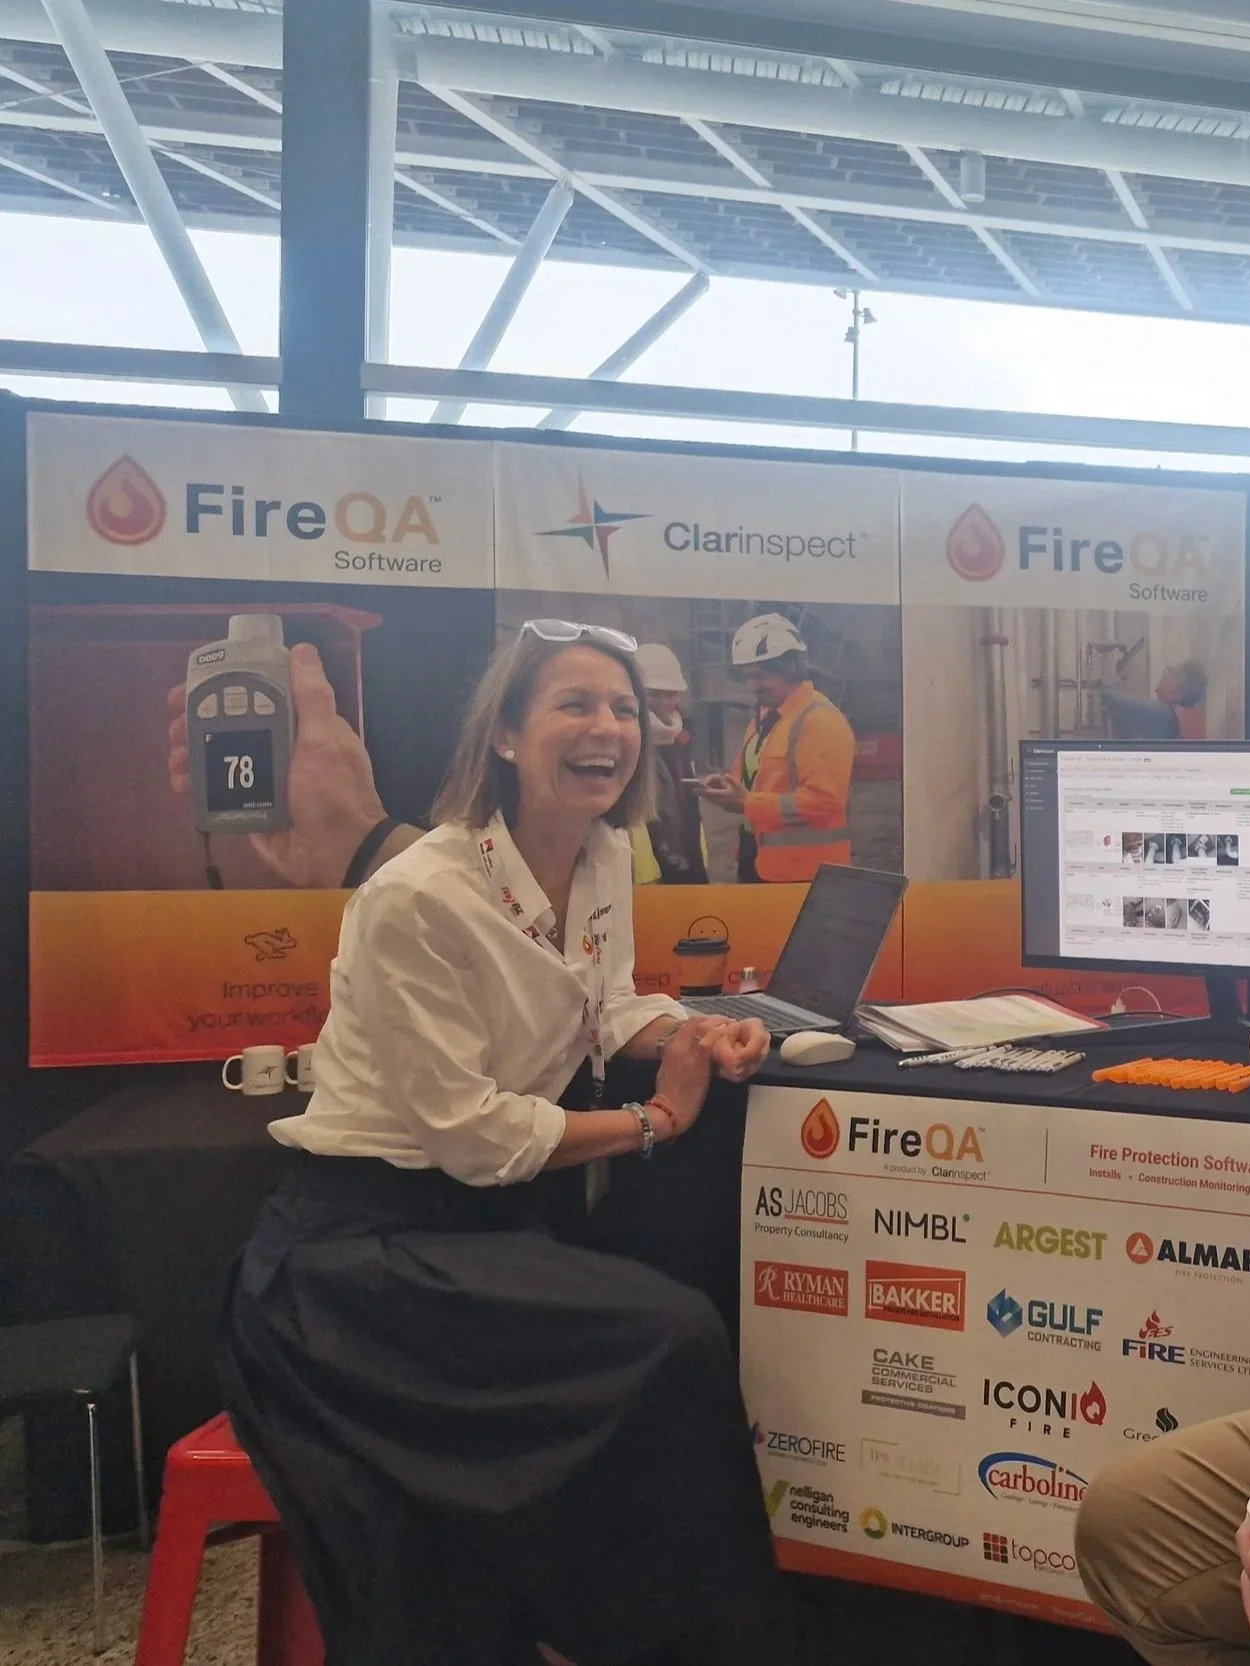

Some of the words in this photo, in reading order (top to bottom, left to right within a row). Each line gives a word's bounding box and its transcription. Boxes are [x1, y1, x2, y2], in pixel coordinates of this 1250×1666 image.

[185, 482, 440, 545] FireQA
[664, 522, 857, 562] Clarinspect
[334, 550, 442, 573] Software
[1129, 583, 1208, 602] Software
[224, 756, 254, 789] 78
[223, 981, 318, 1000] Improve
[849, 1117, 984, 1162] FireQA
[1090, 1144, 1118, 1161] Fire
[1122, 1148, 1199, 1170] Protection
[932, 1166, 987, 1181] Clarinspect
[1089, 1167, 1121, 1180] Installs
[1138, 1172, 1198, 1189] Construction
[1200, 1179, 1250, 1195] Monitoring
[755, 1223, 793, 1238] Property
[794, 1225, 849, 1243] Consultancy
[874, 1208, 967, 1244] NIMBL
[993, 1221, 1107, 1261] ARGEST
[783, 1270, 844, 1297] RYMAN
[783, 1291, 844, 1309] HEALTHCARE
[872, 1283, 956, 1315] BAKKER
[1028, 1299, 1103, 1335] GULF
[1028, 1331, 1102, 1351] CONTRACTING
[873, 1348, 934, 1370] CAKE
[1190, 1359, 1234, 1373] SERVICES
[872, 1367, 956, 1387] COMMERCIAL
[872, 1377, 933, 1393] SERVICES
[983, 1378, 1107, 1427] ICONIQ
[1010, 1417, 1071, 1439] FIRE
[767, 1431, 846, 1462] ZEROFIRE
[789, 1485, 834, 1503] nelligan
[790, 1500, 850, 1523] consulting
[791, 1512, 848, 1533] engineers
[892, 1522, 970, 1548] INTERGROUP
